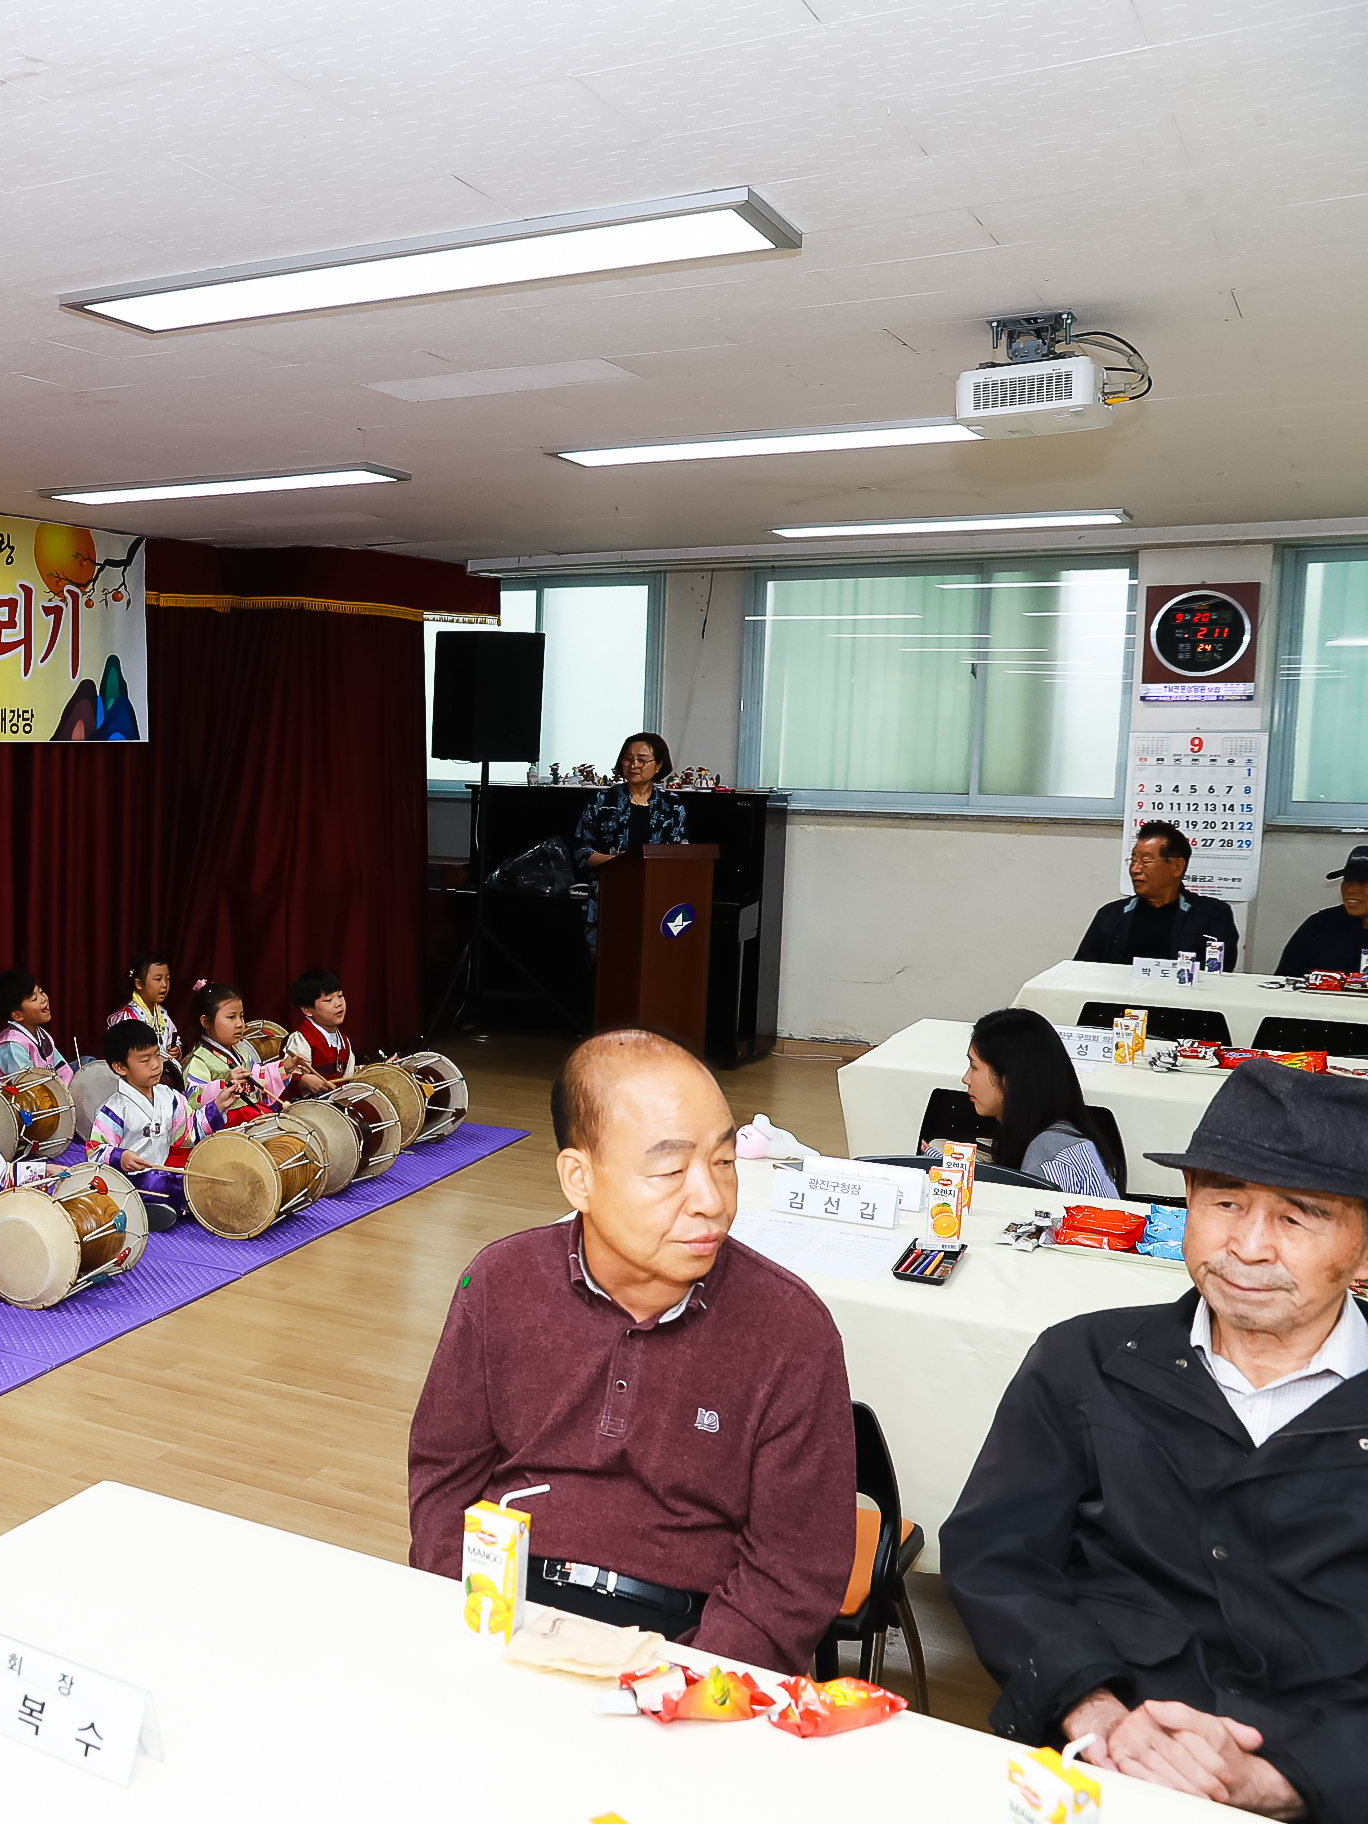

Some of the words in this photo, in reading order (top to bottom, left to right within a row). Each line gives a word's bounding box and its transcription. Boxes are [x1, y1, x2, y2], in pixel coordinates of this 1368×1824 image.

[1175, 613, 1184, 623] 9
[1193, 612, 1210, 623] 20
[1197, 643, 1212, 652] 24
[1189, 736, 1204, 754] 9
[1246, 768, 1252, 777] 1
[1138, 783, 1145, 793] 2
[1155, 784, 1162, 793] 3
[1172, 784, 1180, 793] 4
[1190, 785, 1197, 794] 5
[1208, 785, 1215, 794] 6
[1226, 785, 1233, 794] 7
[1244, 785, 1252, 795] 8
[1137, 801, 1144, 810] 9
[1151, 801, 1164, 811] 10
[1169, 802, 1181, 811] 11
[1186, 802, 1199, 812] 12
[1204, 803, 1217, 812] 13
[1222, 803, 1235, 812] 14
[1240, 804, 1253, 813] 15
[1185, 820, 1198, 829] 19
[1202, 821, 1217, 830] 20
[1221, 821, 1235, 831] 21
[1238, 821, 1253, 831] 22
[1201, 838, 1216, 848] 27
[1219, 839, 1234, 848] 28
[1237, 839, 1252, 849] 29
[1183, 874, 1214, 883] 마을금고
[1059, 1031, 1073, 1040] 진구
[1076, 1033, 1099, 1043] 구의회
[808, 1177, 862, 1197] 광진구청장
[932, 1187, 956, 1198] 오렌지
[466, 1545, 503, 1565] MANGO
